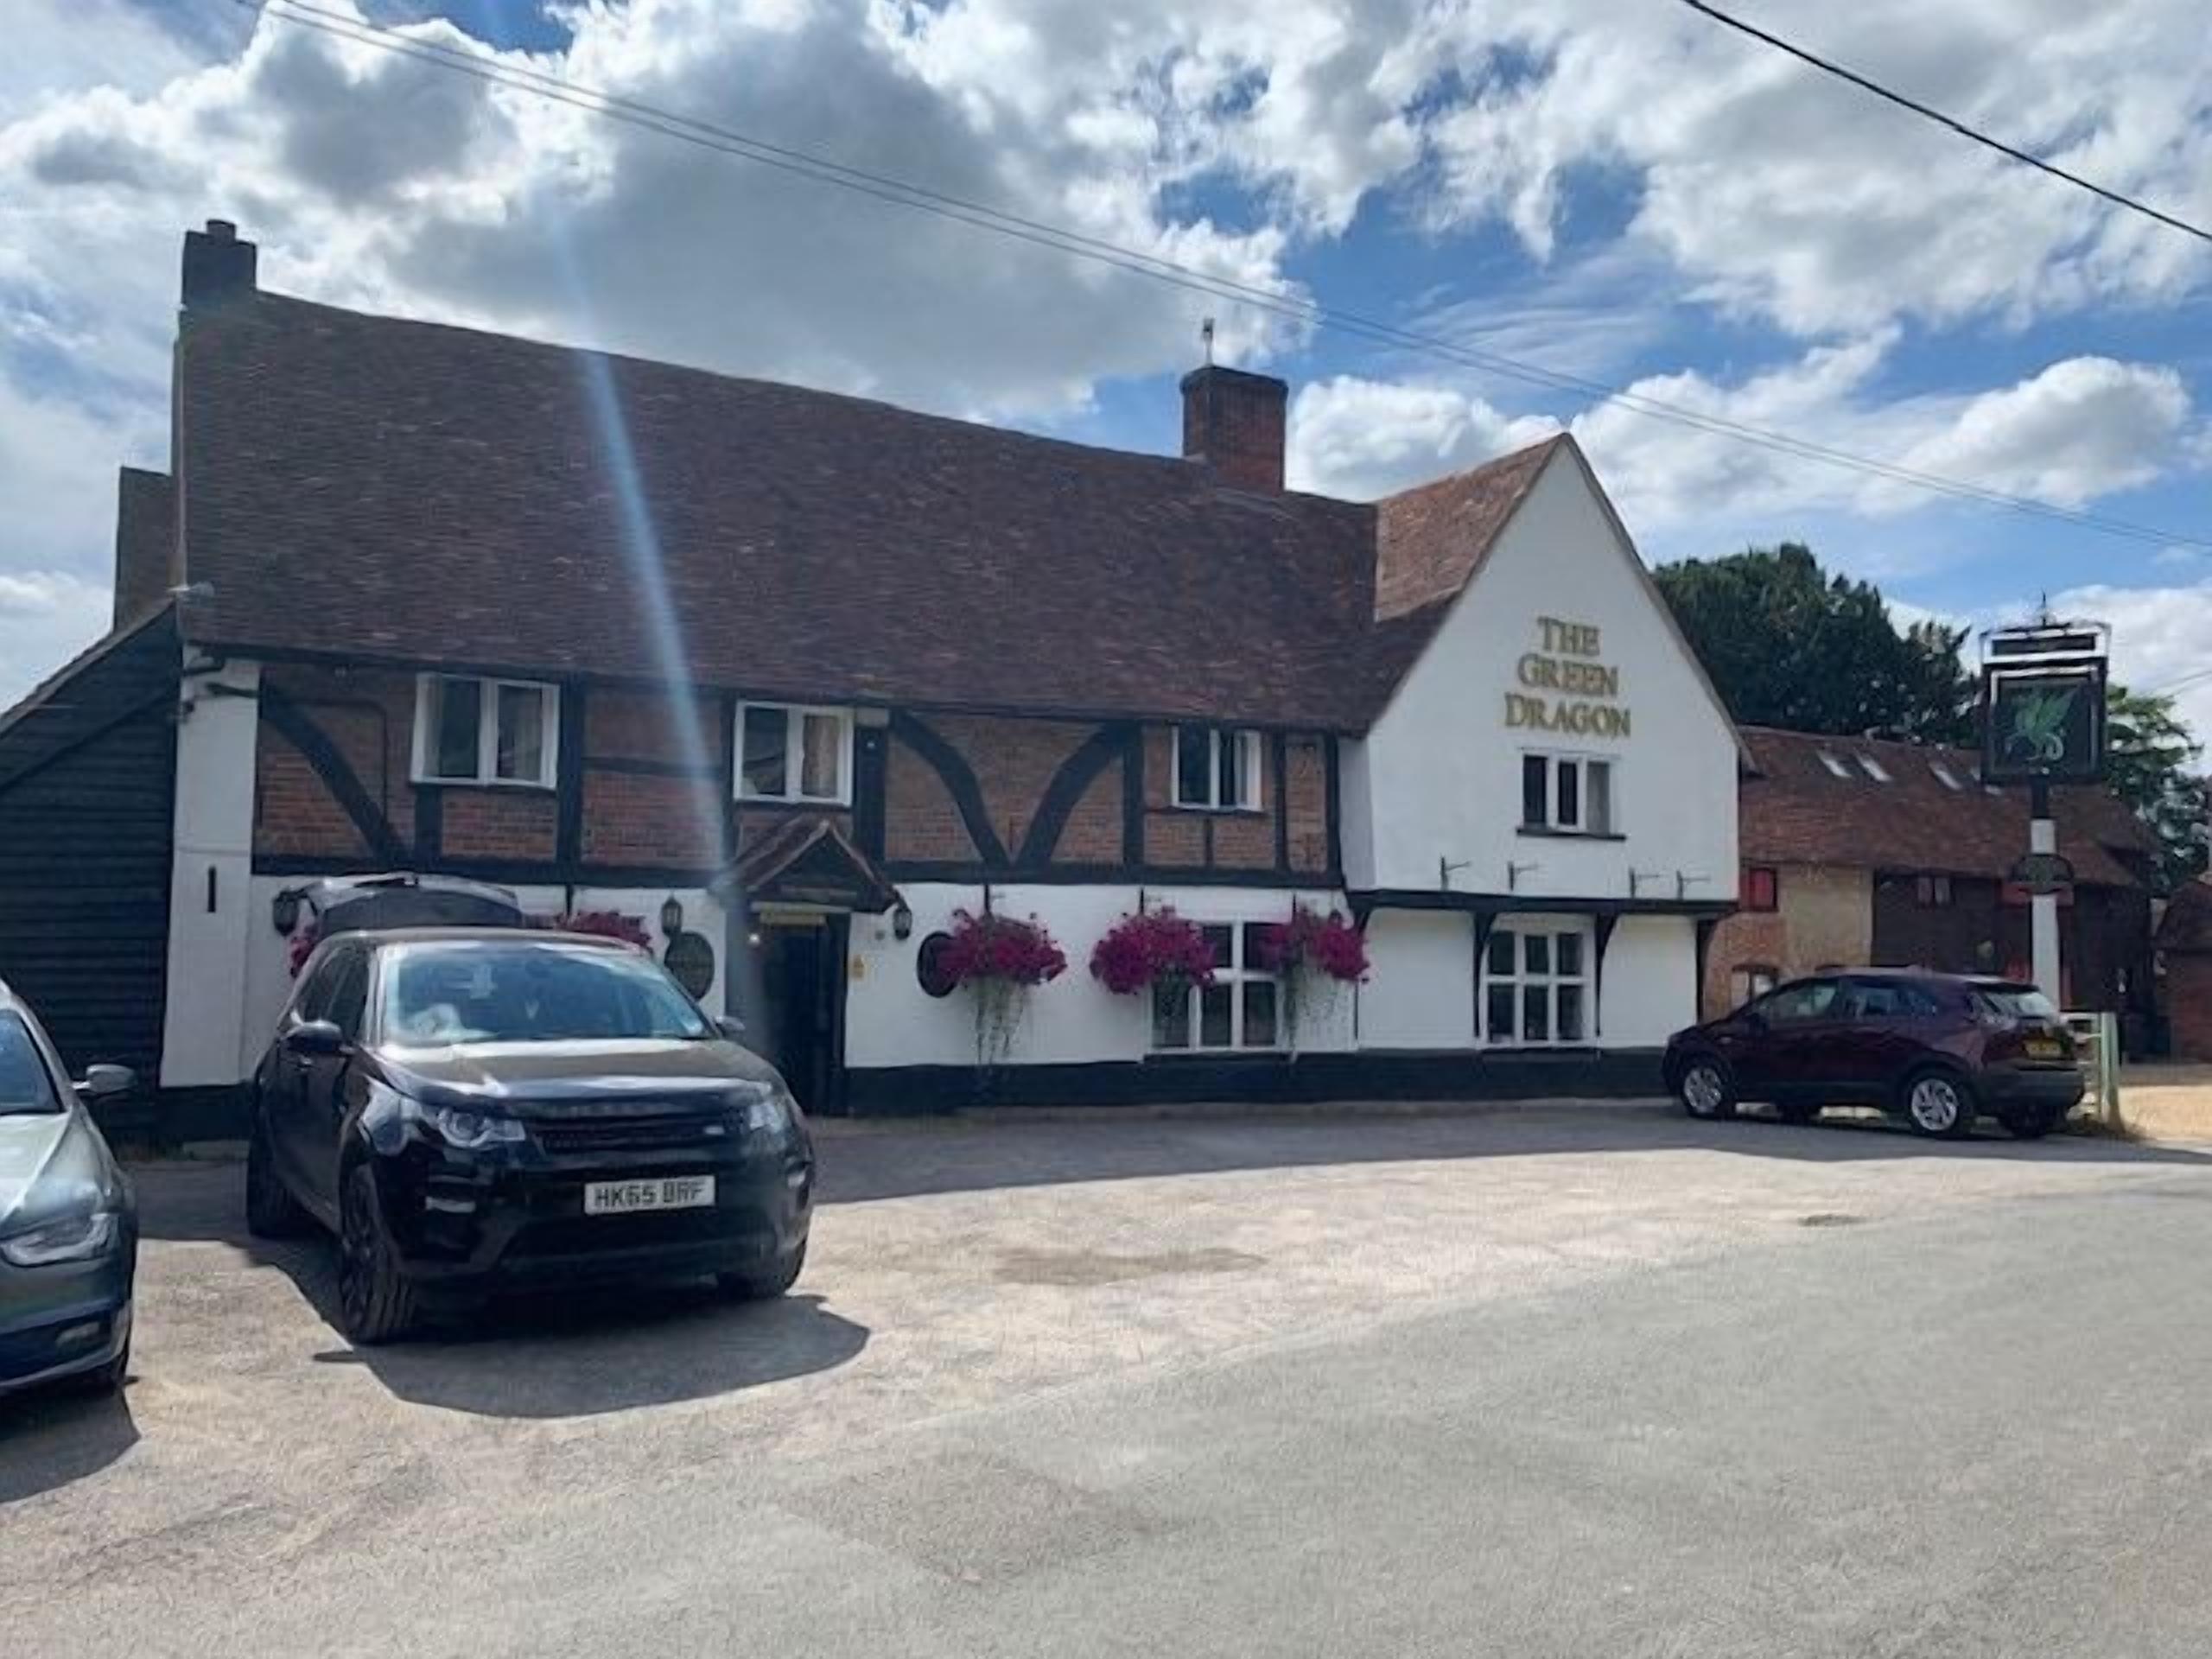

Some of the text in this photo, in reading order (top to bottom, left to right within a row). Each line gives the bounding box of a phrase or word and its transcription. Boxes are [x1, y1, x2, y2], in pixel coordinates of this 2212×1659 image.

[1536, 616, 1600, 656] THE
[1517, 652, 1618, 696] GREEN
[1503, 692, 1631, 737] DRAGON
[594, 1185, 658, 1207] HK65
